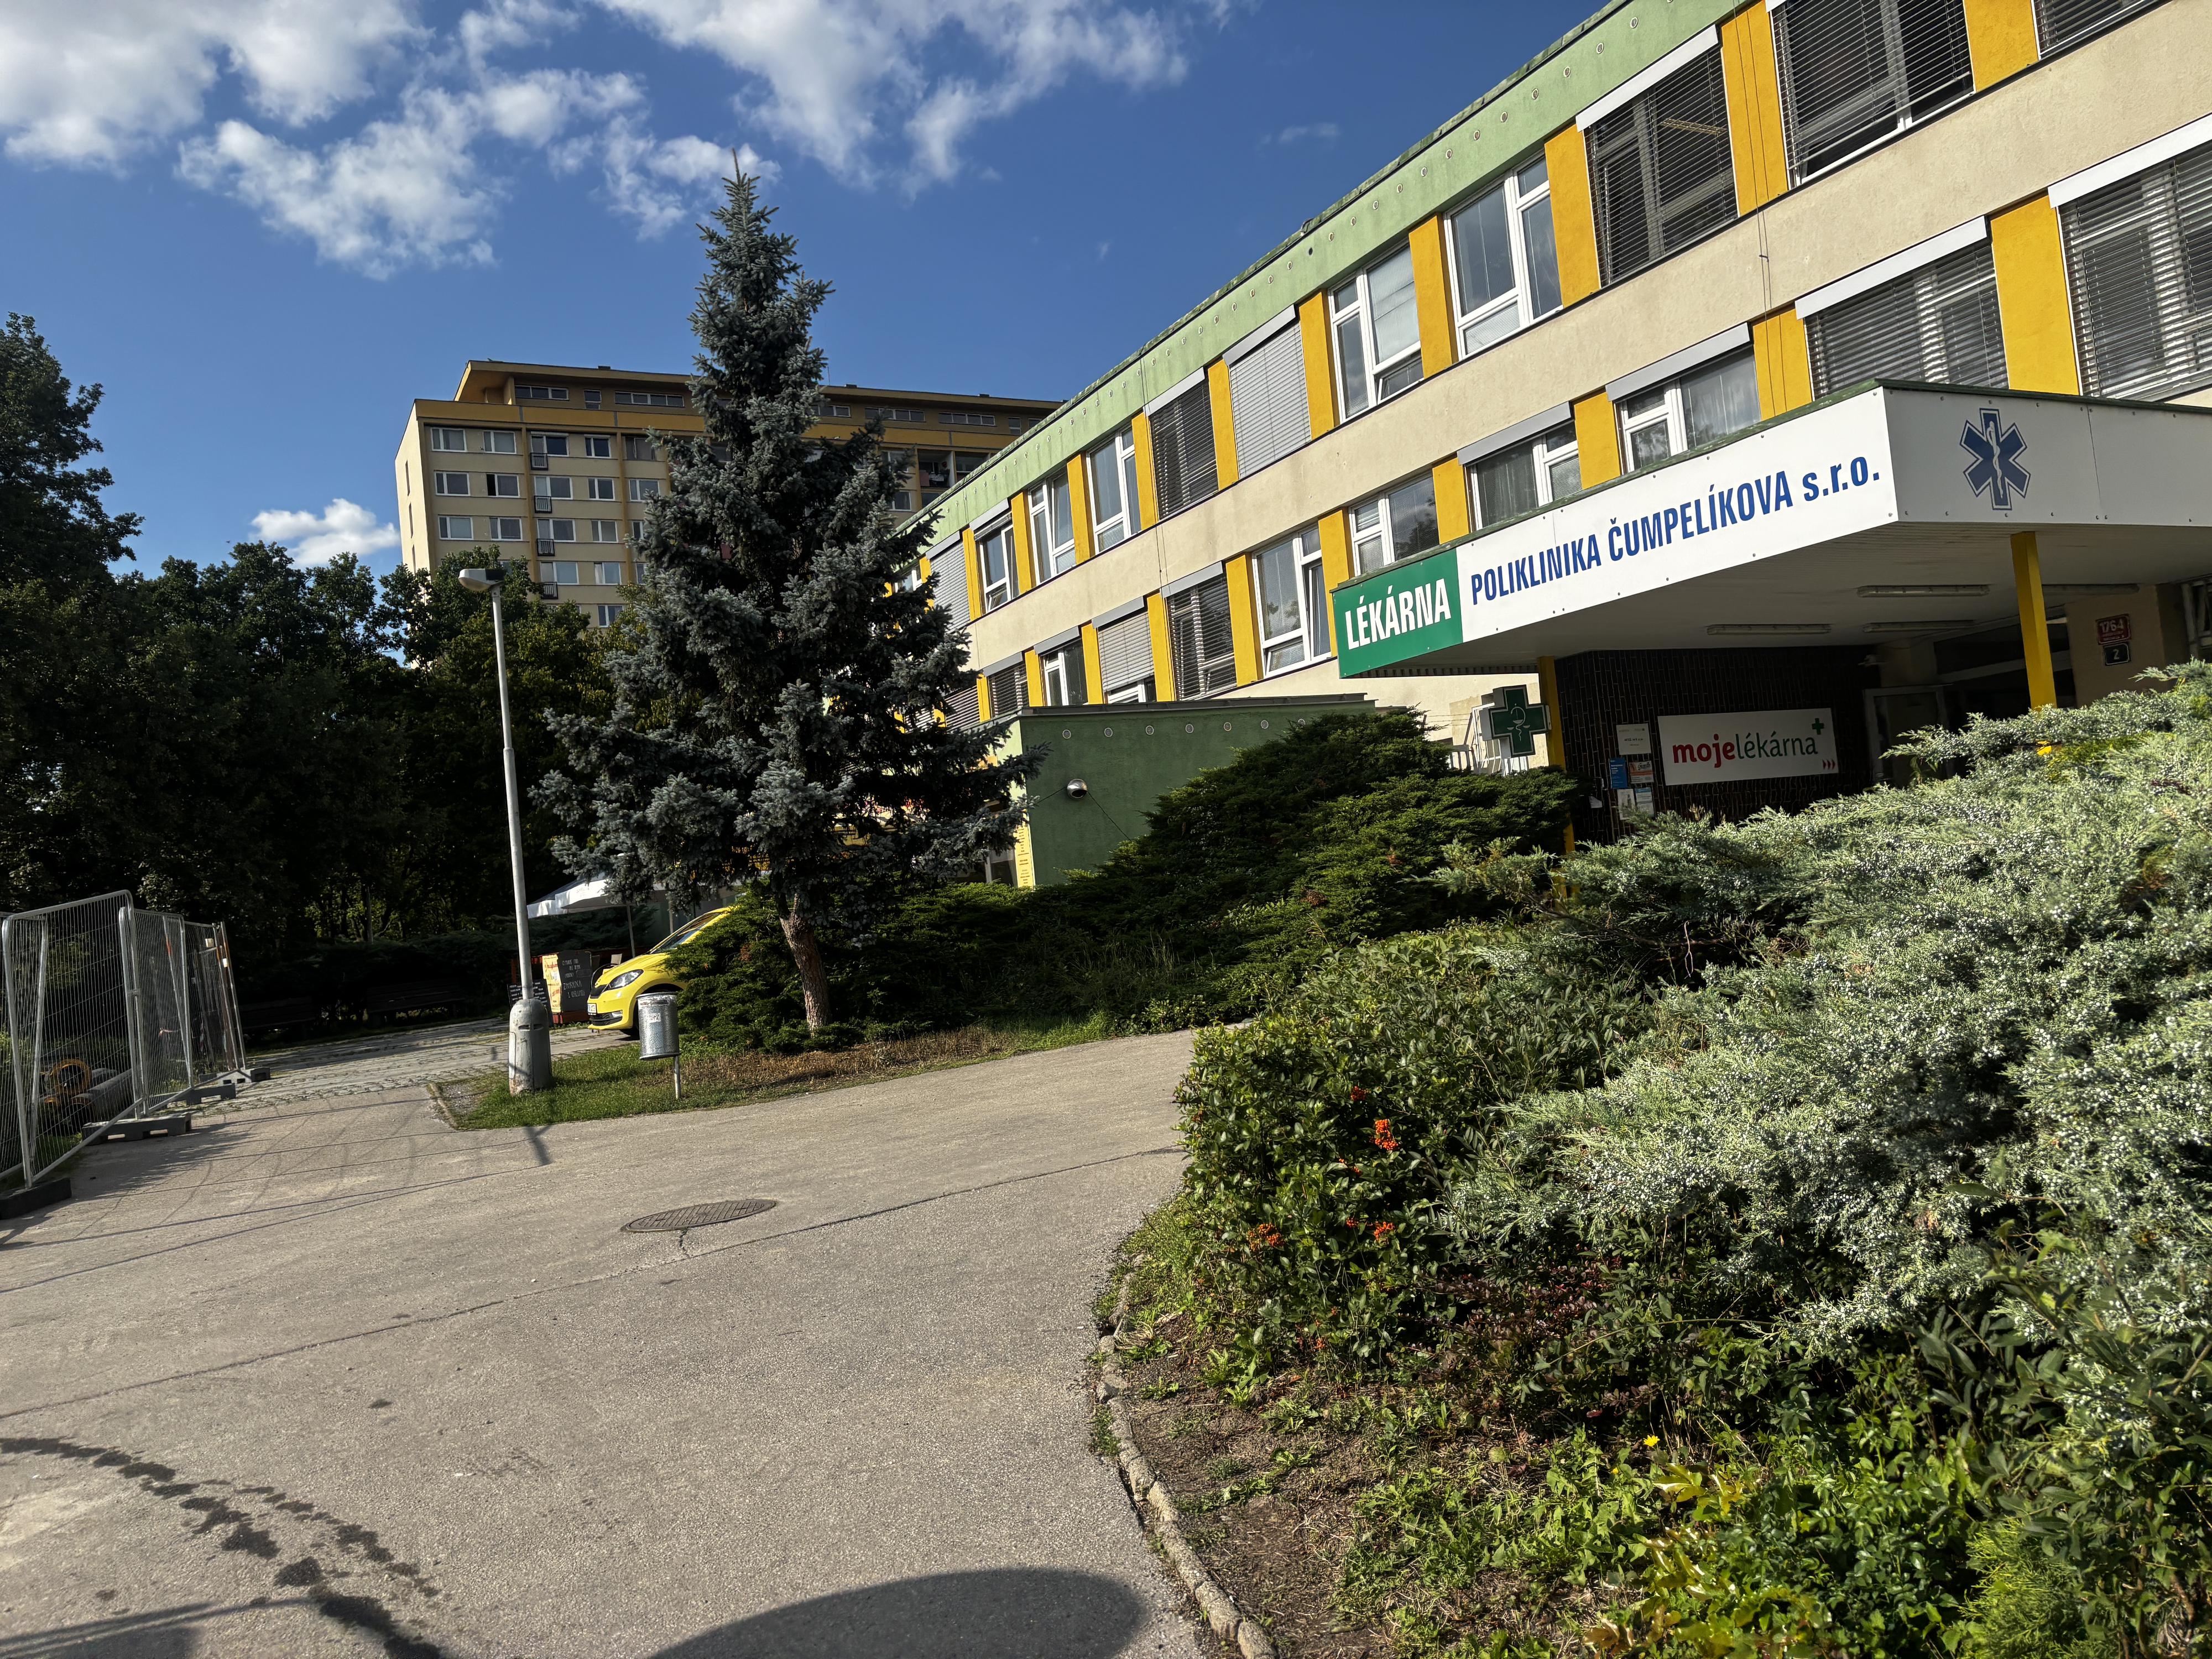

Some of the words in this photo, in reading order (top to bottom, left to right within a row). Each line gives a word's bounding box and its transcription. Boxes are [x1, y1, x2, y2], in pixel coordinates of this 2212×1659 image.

[1471, 534, 1602, 606] POLIKLINIKA
[1608, 470, 1793, 561] ČUMPELÍKOVA
[1802, 456, 1880, 502] s.r.o.
[1345, 578, 1452, 650] LÉKÁRNA
[2100, 618, 2124, 633] 1764
[2113, 649, 2120, 660] 2
